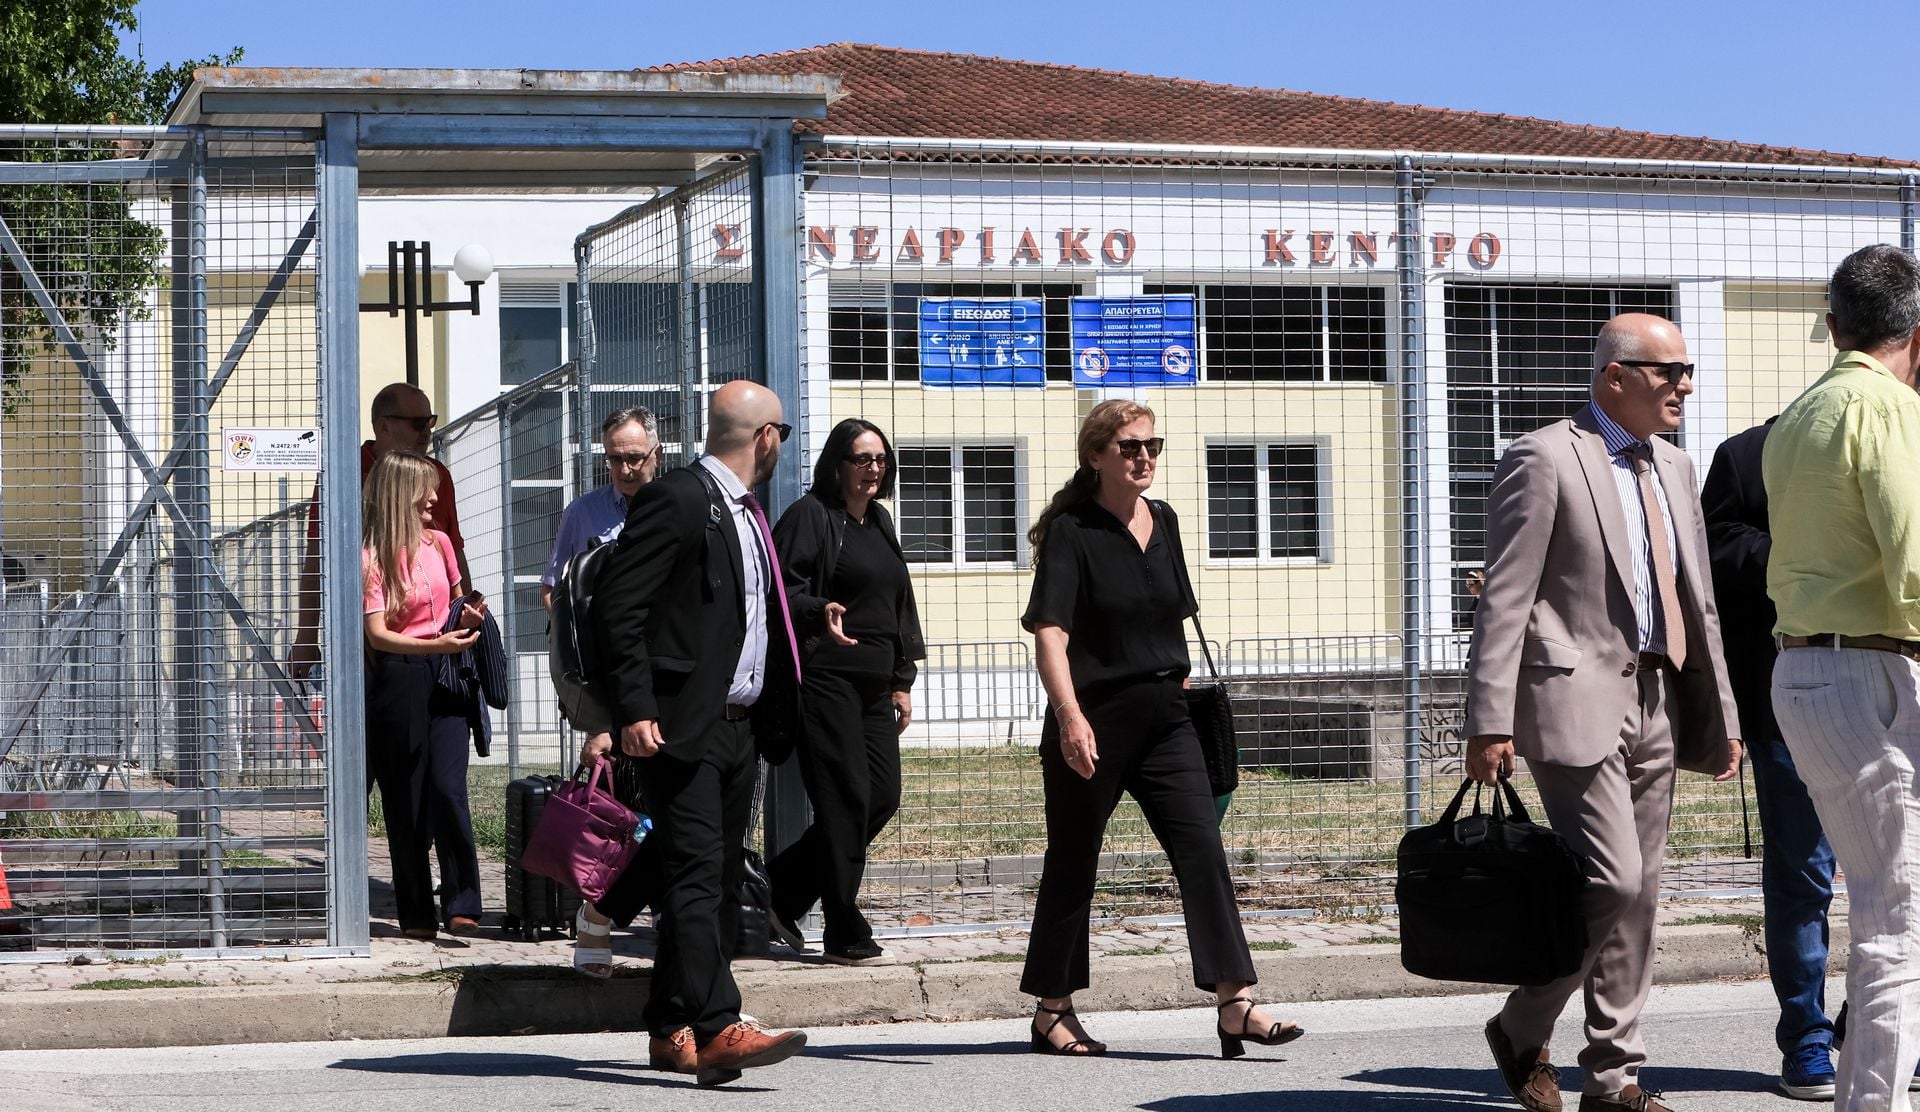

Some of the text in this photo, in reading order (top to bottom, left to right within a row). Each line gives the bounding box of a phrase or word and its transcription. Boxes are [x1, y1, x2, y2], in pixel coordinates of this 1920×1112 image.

[714, 223, 1136, 262] ΣΝΕΔΡΙΑΚΟ
[953, 309, 1011, 320] ΕΙΣΟΔΟΣ
[229, 435, 255, 443] TOWN
